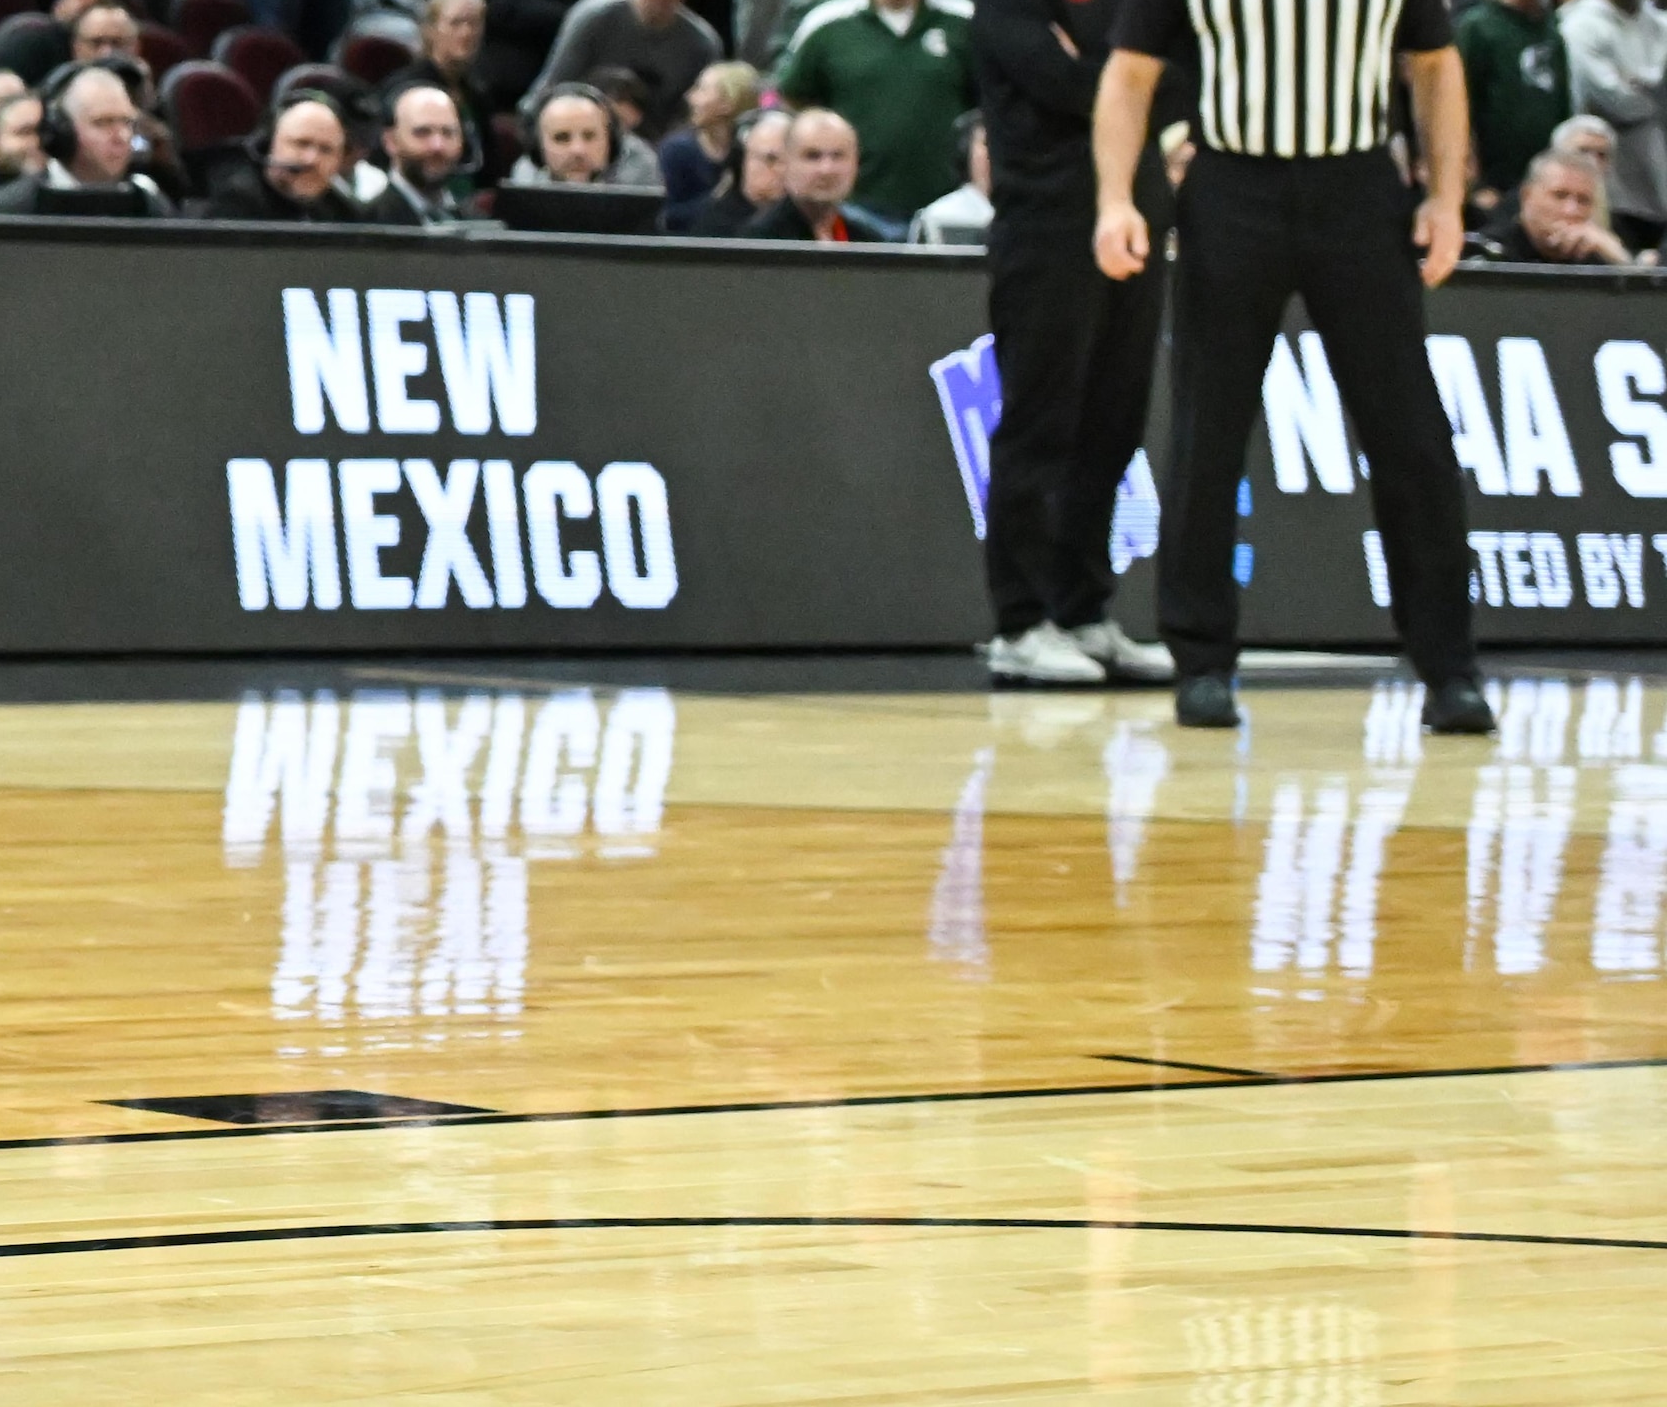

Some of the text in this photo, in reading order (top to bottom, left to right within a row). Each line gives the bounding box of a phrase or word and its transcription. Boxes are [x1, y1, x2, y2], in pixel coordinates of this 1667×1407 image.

[281, 287, 538, 437] NEW
[1261, 330, 1584, 498] NAA
[225, 456, 679, 611] MEXICO
[1576, 532, 1647, 609] BY
